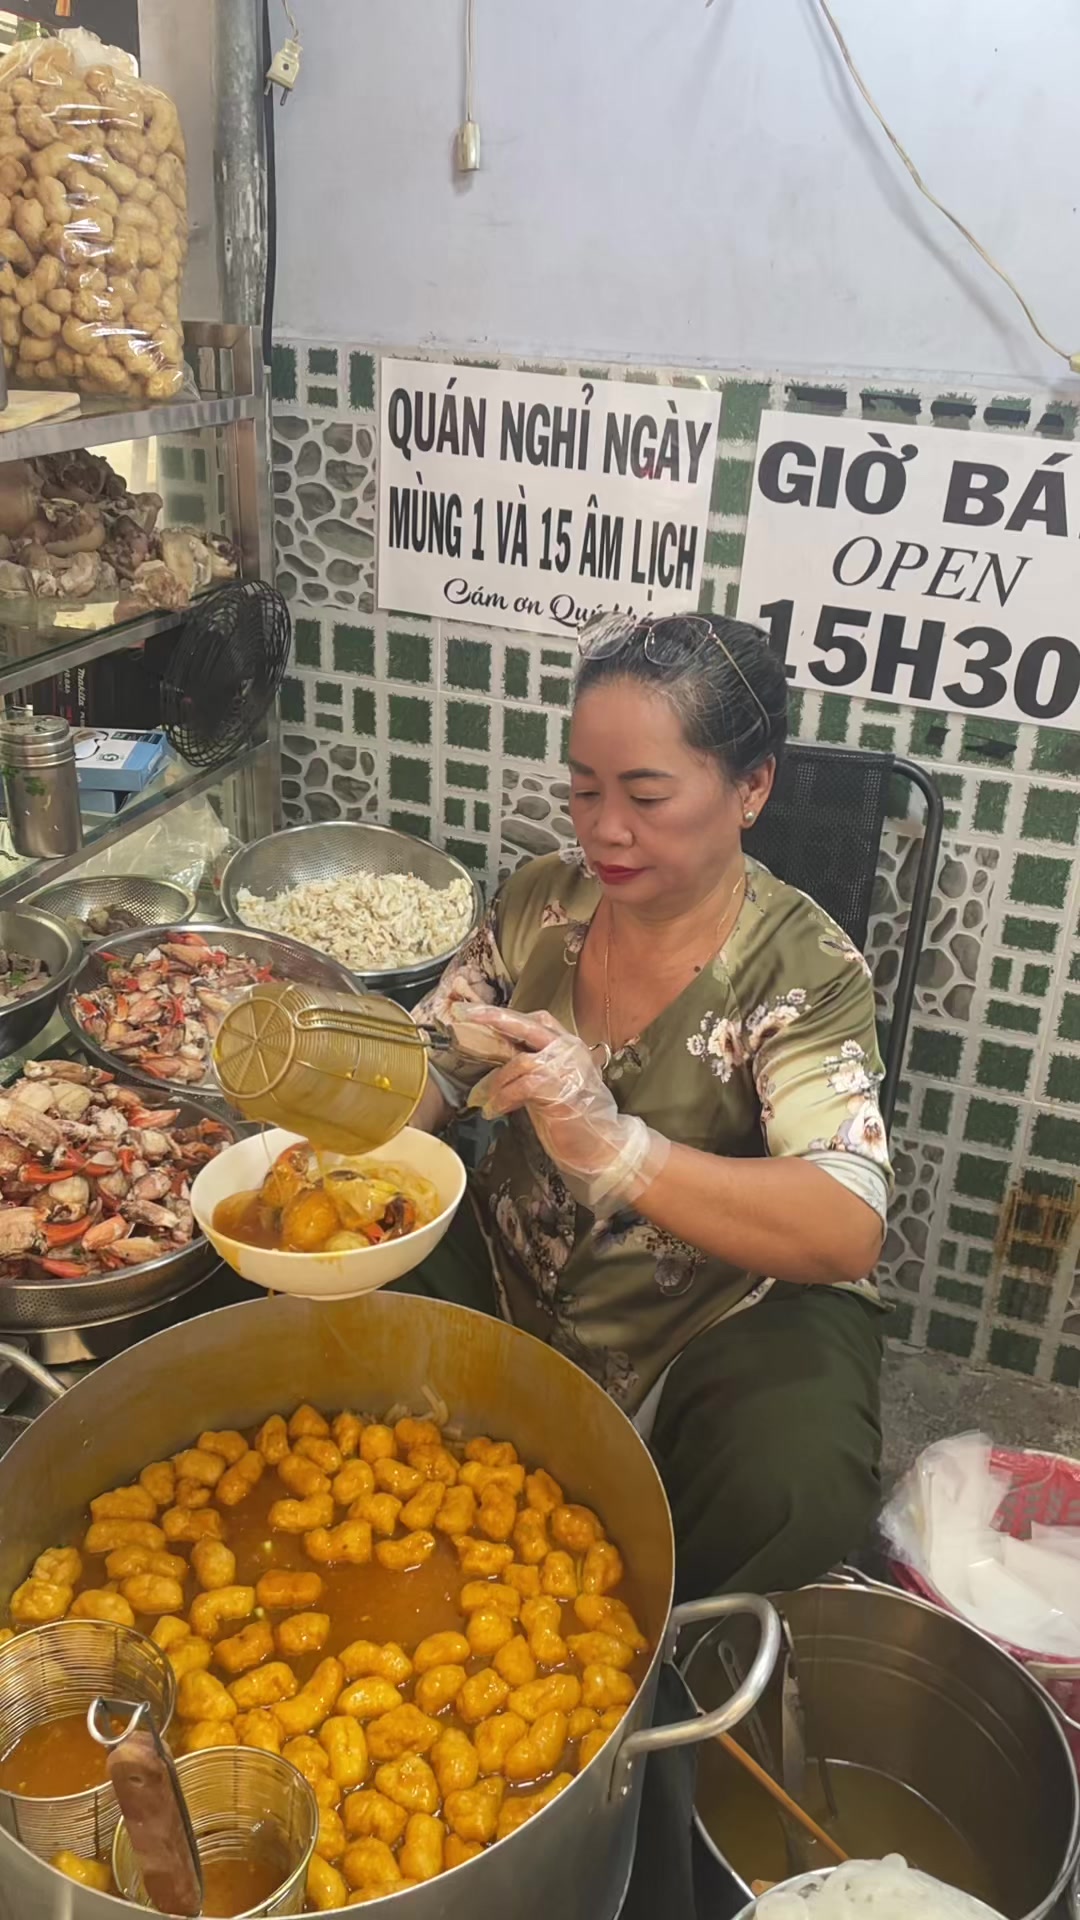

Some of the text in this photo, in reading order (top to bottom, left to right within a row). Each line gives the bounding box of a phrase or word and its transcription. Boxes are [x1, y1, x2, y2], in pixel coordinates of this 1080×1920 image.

[388, 377, 712, 484] QUÁN NGHỈ NGÀY
[389, 471, 698, 602] MÙNG 1 VÀ 15 ÂM LỊCH
[757, 432, 1080, 540] GIỜ BÁ
[443, 577, 508, 610] Cám
[832, 536, 1033, 607] OPEN
[759, 598, 1080, 719] 15H30
